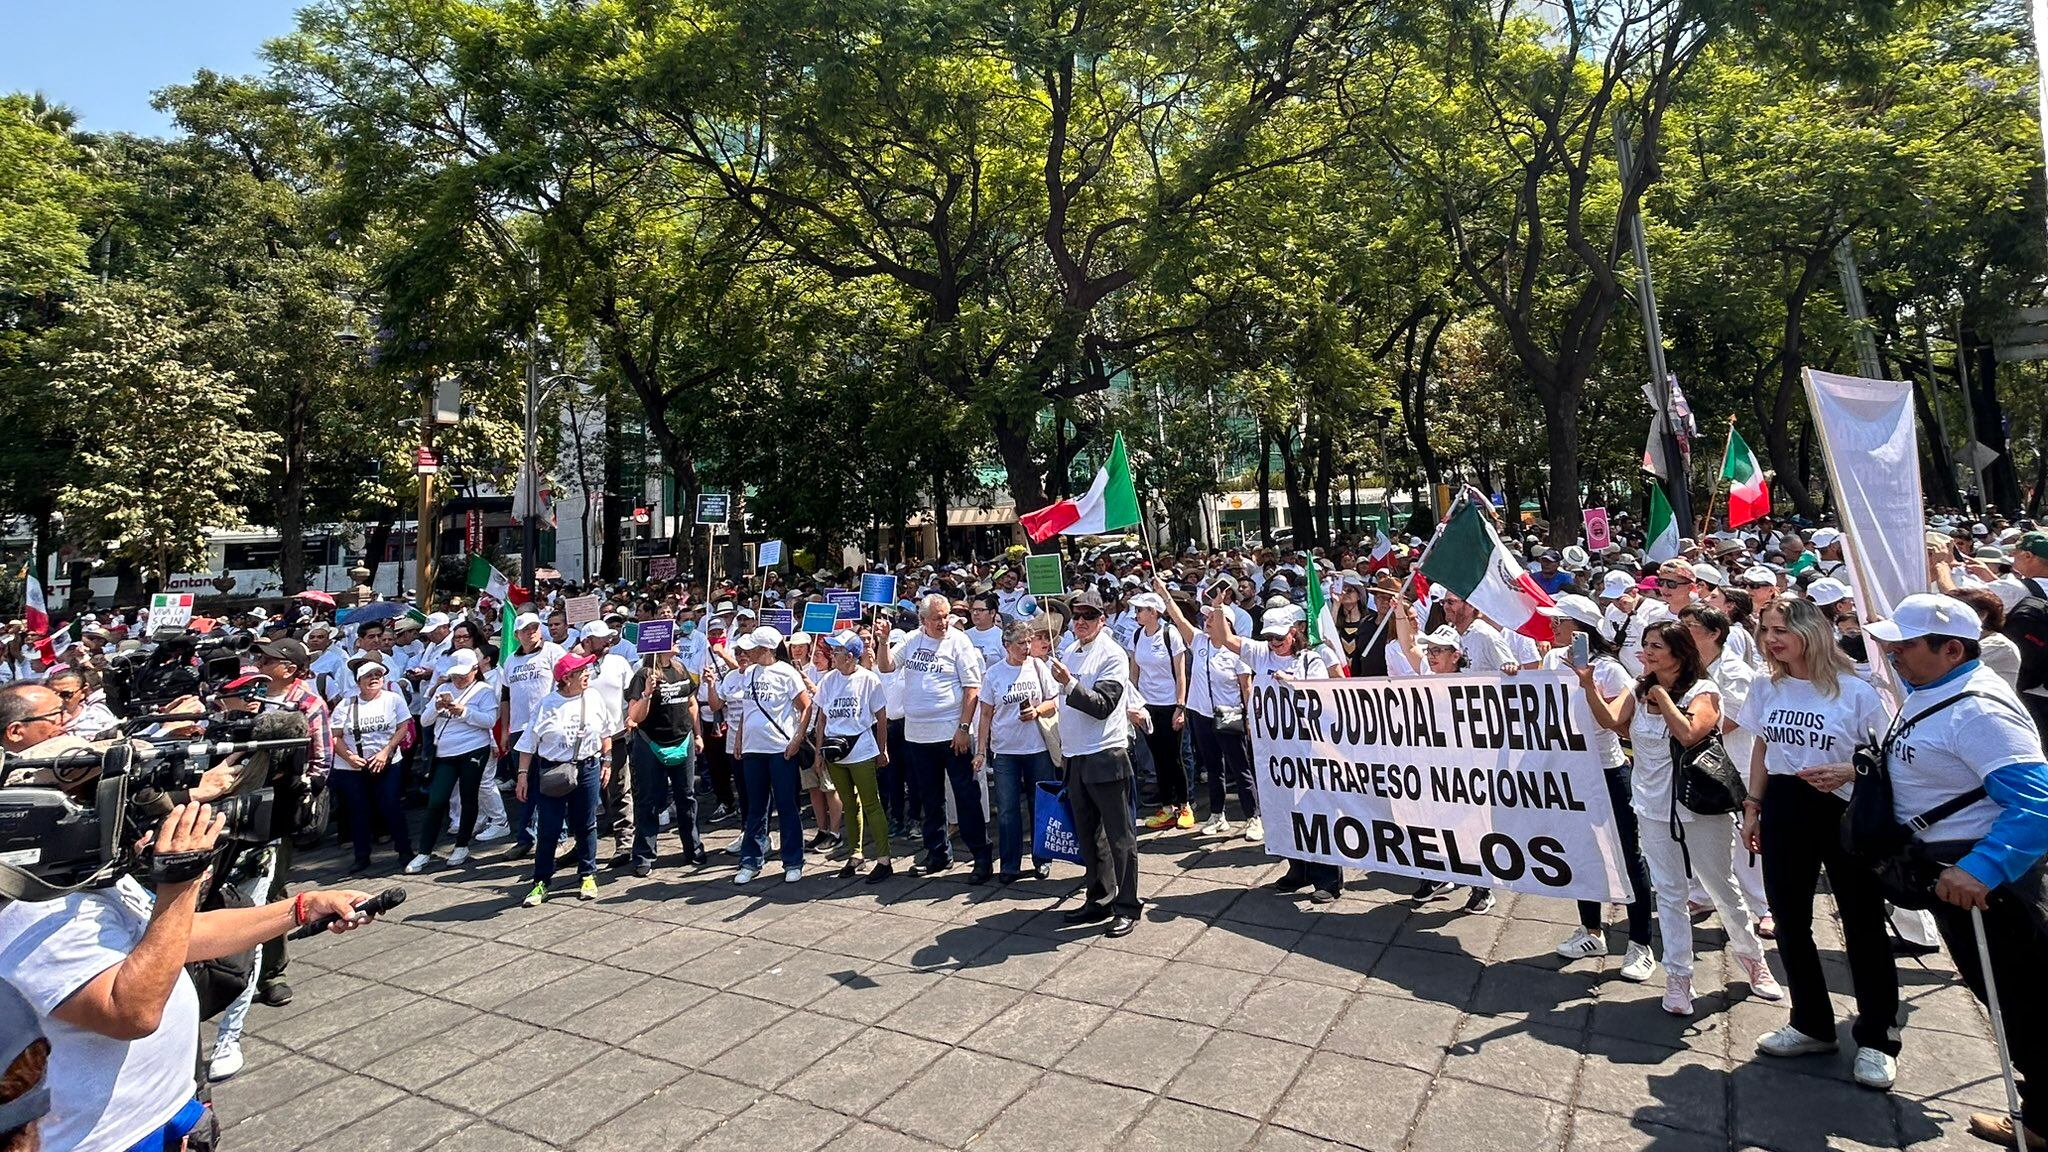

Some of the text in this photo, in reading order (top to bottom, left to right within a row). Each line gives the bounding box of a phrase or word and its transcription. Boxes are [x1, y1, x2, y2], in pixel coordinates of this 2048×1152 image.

[154, 608, 171, 616] VIVA
[911, 650, 939, 663] #TODOS
[905, 660, 944, 674] SOMOS PJF
[529, 670, 541, 680] PJF
[1007, 681, 1037, 693] #TODOS
[1002, 692, 1029, 706] SOMOS
[852, 707, 863, 718] PF
[1253, 683, 1588, 751] PODER JUDICIAL FEDERAL
[1768, 709, 1825, 730] #TODOS
[359, 714, 385, 726] TODOS
[1763, 725, 1836, 751] SOMOS PJF
[1895, 739, 1916, 764] PJF
[1269, 755, 1586, 811] CONTRAPESO NACIONAL
[1048, 817, 1063, 830] EAT
[1045, 832, 1076, 847] TRADE
[1046, 825, 1074, 840] SLEEP
[1044, 841, 1080, 855] REPEAT
[1291, 811, 1573, 887] MORELOS
